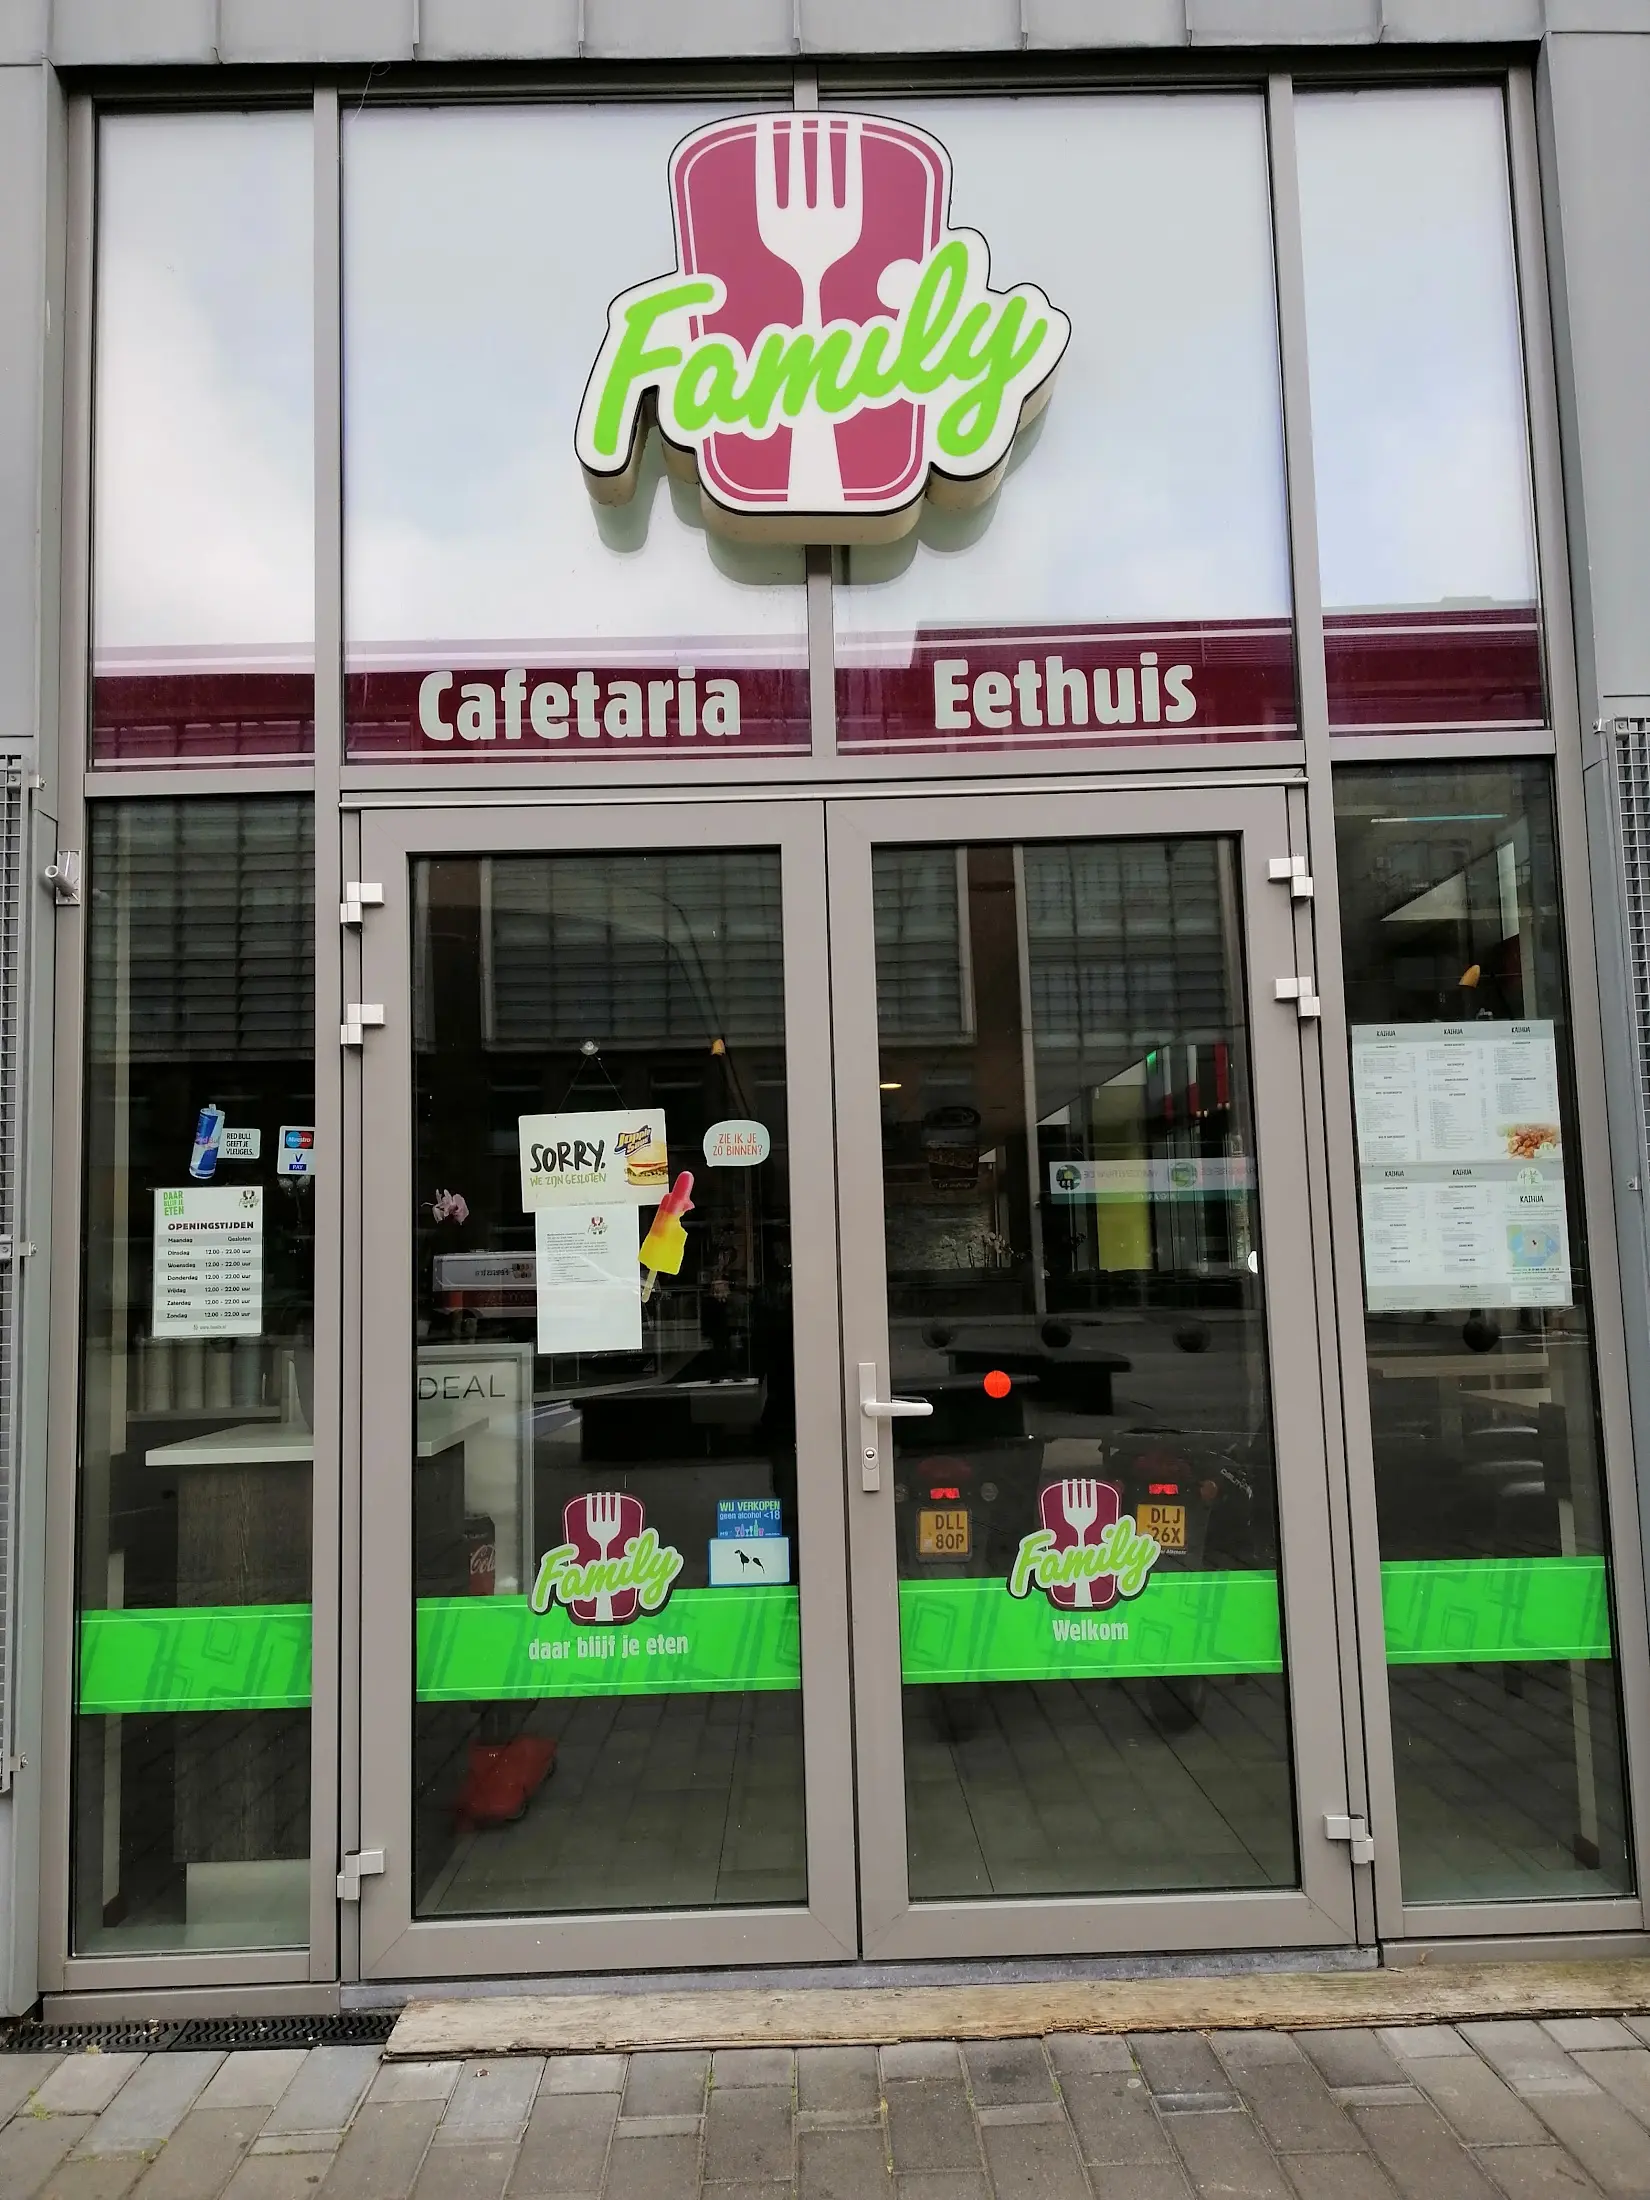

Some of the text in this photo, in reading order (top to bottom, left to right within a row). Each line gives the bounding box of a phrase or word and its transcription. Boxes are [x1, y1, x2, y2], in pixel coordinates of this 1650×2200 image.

[593, 240, 1048, 457] Family
[933, 652, 1197, 730] Eethuis
[418, 666, 742, 742] Cafetaria
[1376, 1029, 1396, 1038] KAIHUA
[1443, 1028, 1464, 1036] KAIHUA
[1511, 1026, 1531, 1034] KAIHUA
[226, 1132, 251, 1140] RED BULL
[719, 1132, 757, 1144] ZIE IK JE
[226, 1140, 249, 1148] GEEFT JE
[713, 1144, 763, 1156] ZO BINNEN?
[530, 1139, 606, 1173] SORRY.
[1384, 1170, 1404, 1178] KAIHUA
[1452, 1168, 1472, 1176] KAIHUA
[530, 1172, 607, 1188] WE ZIJN GESLOTEN
[163, 1190, 183, 1200] DAAR
[1519, 1194, 1544, 1203] KAIHUA
[164, 1205, 184, 1216] ETEN
[168, 1221, 254, 1231] OPENINGSTIJDEN
[719, 1500, 780, 1512] WIJ VERKOPEN
[719, 1510, 780, 1520] geen alcohol <18
[1151, 1507, 1181, 1524] DLJ
[935, 1513, 965, 1530] DLL
[935, 1532, 965, 1550] 80P
[1014, 1518, 1157, 1592] Family
[535, 1530, 679, 1608] Family
[1052, 1618, 1129, 1642] Welkom
[528, 1634, 689, 1660] daar blijf je eten
